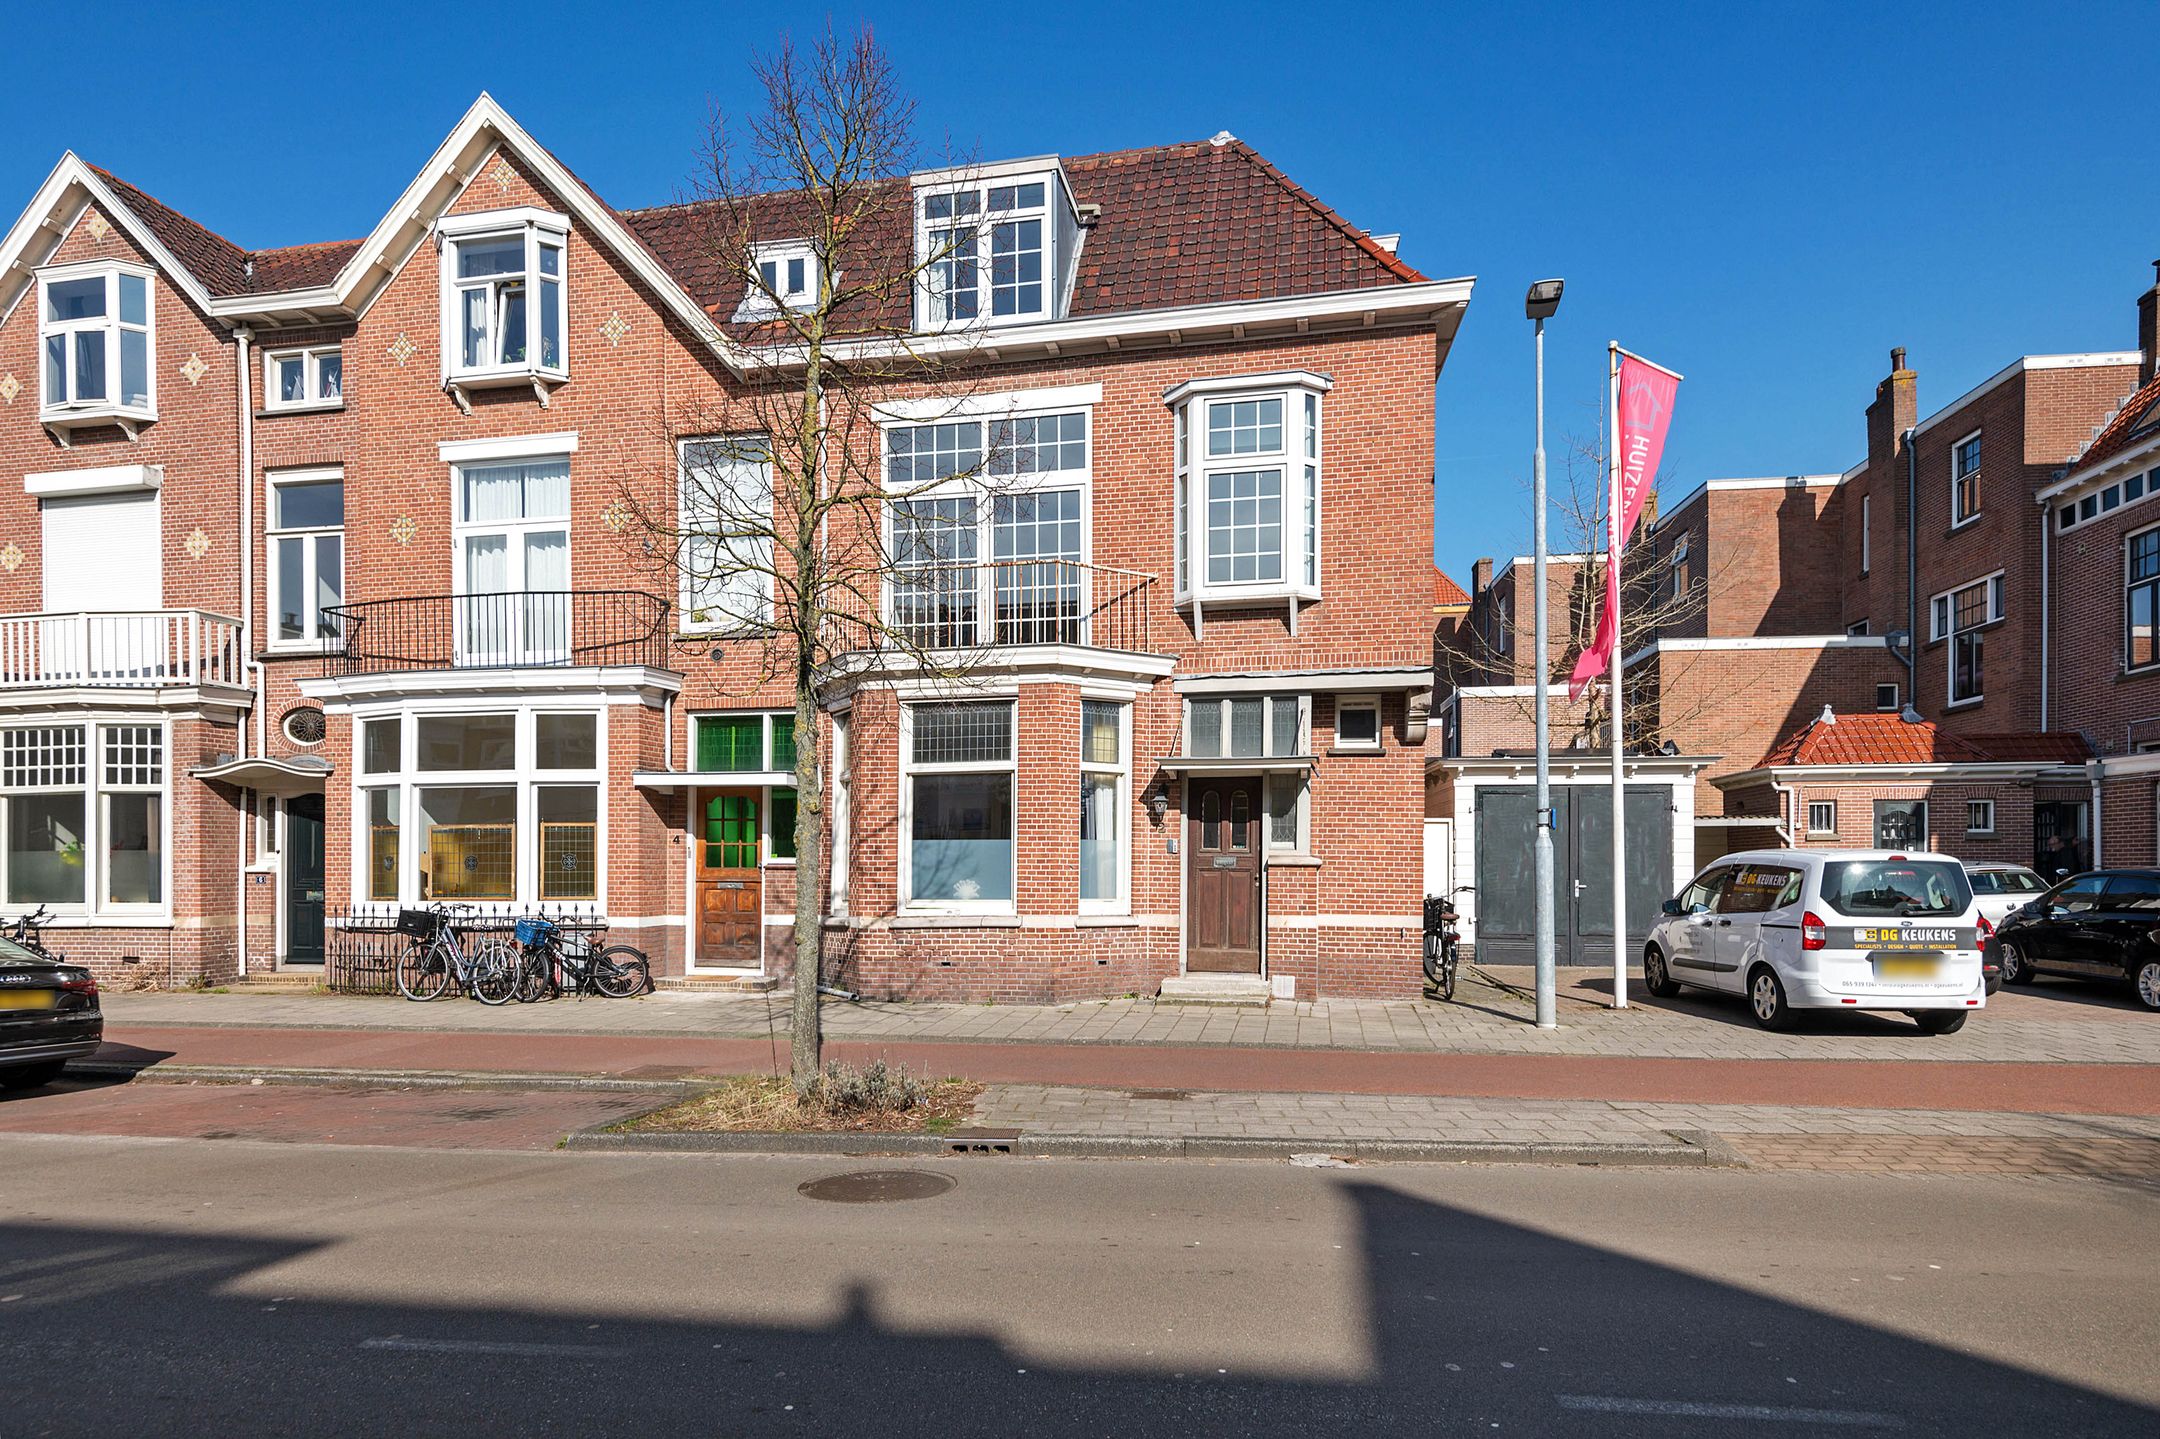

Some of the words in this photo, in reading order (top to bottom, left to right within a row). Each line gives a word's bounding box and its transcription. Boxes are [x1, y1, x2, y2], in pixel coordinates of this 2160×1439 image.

[672, 835, 680, 844] 4
[1756, 874, 1787, 886] KEUKENS
[1881, 929, 1898, 941] DG
[1902, 929, 1956, 941] KEUKENS
